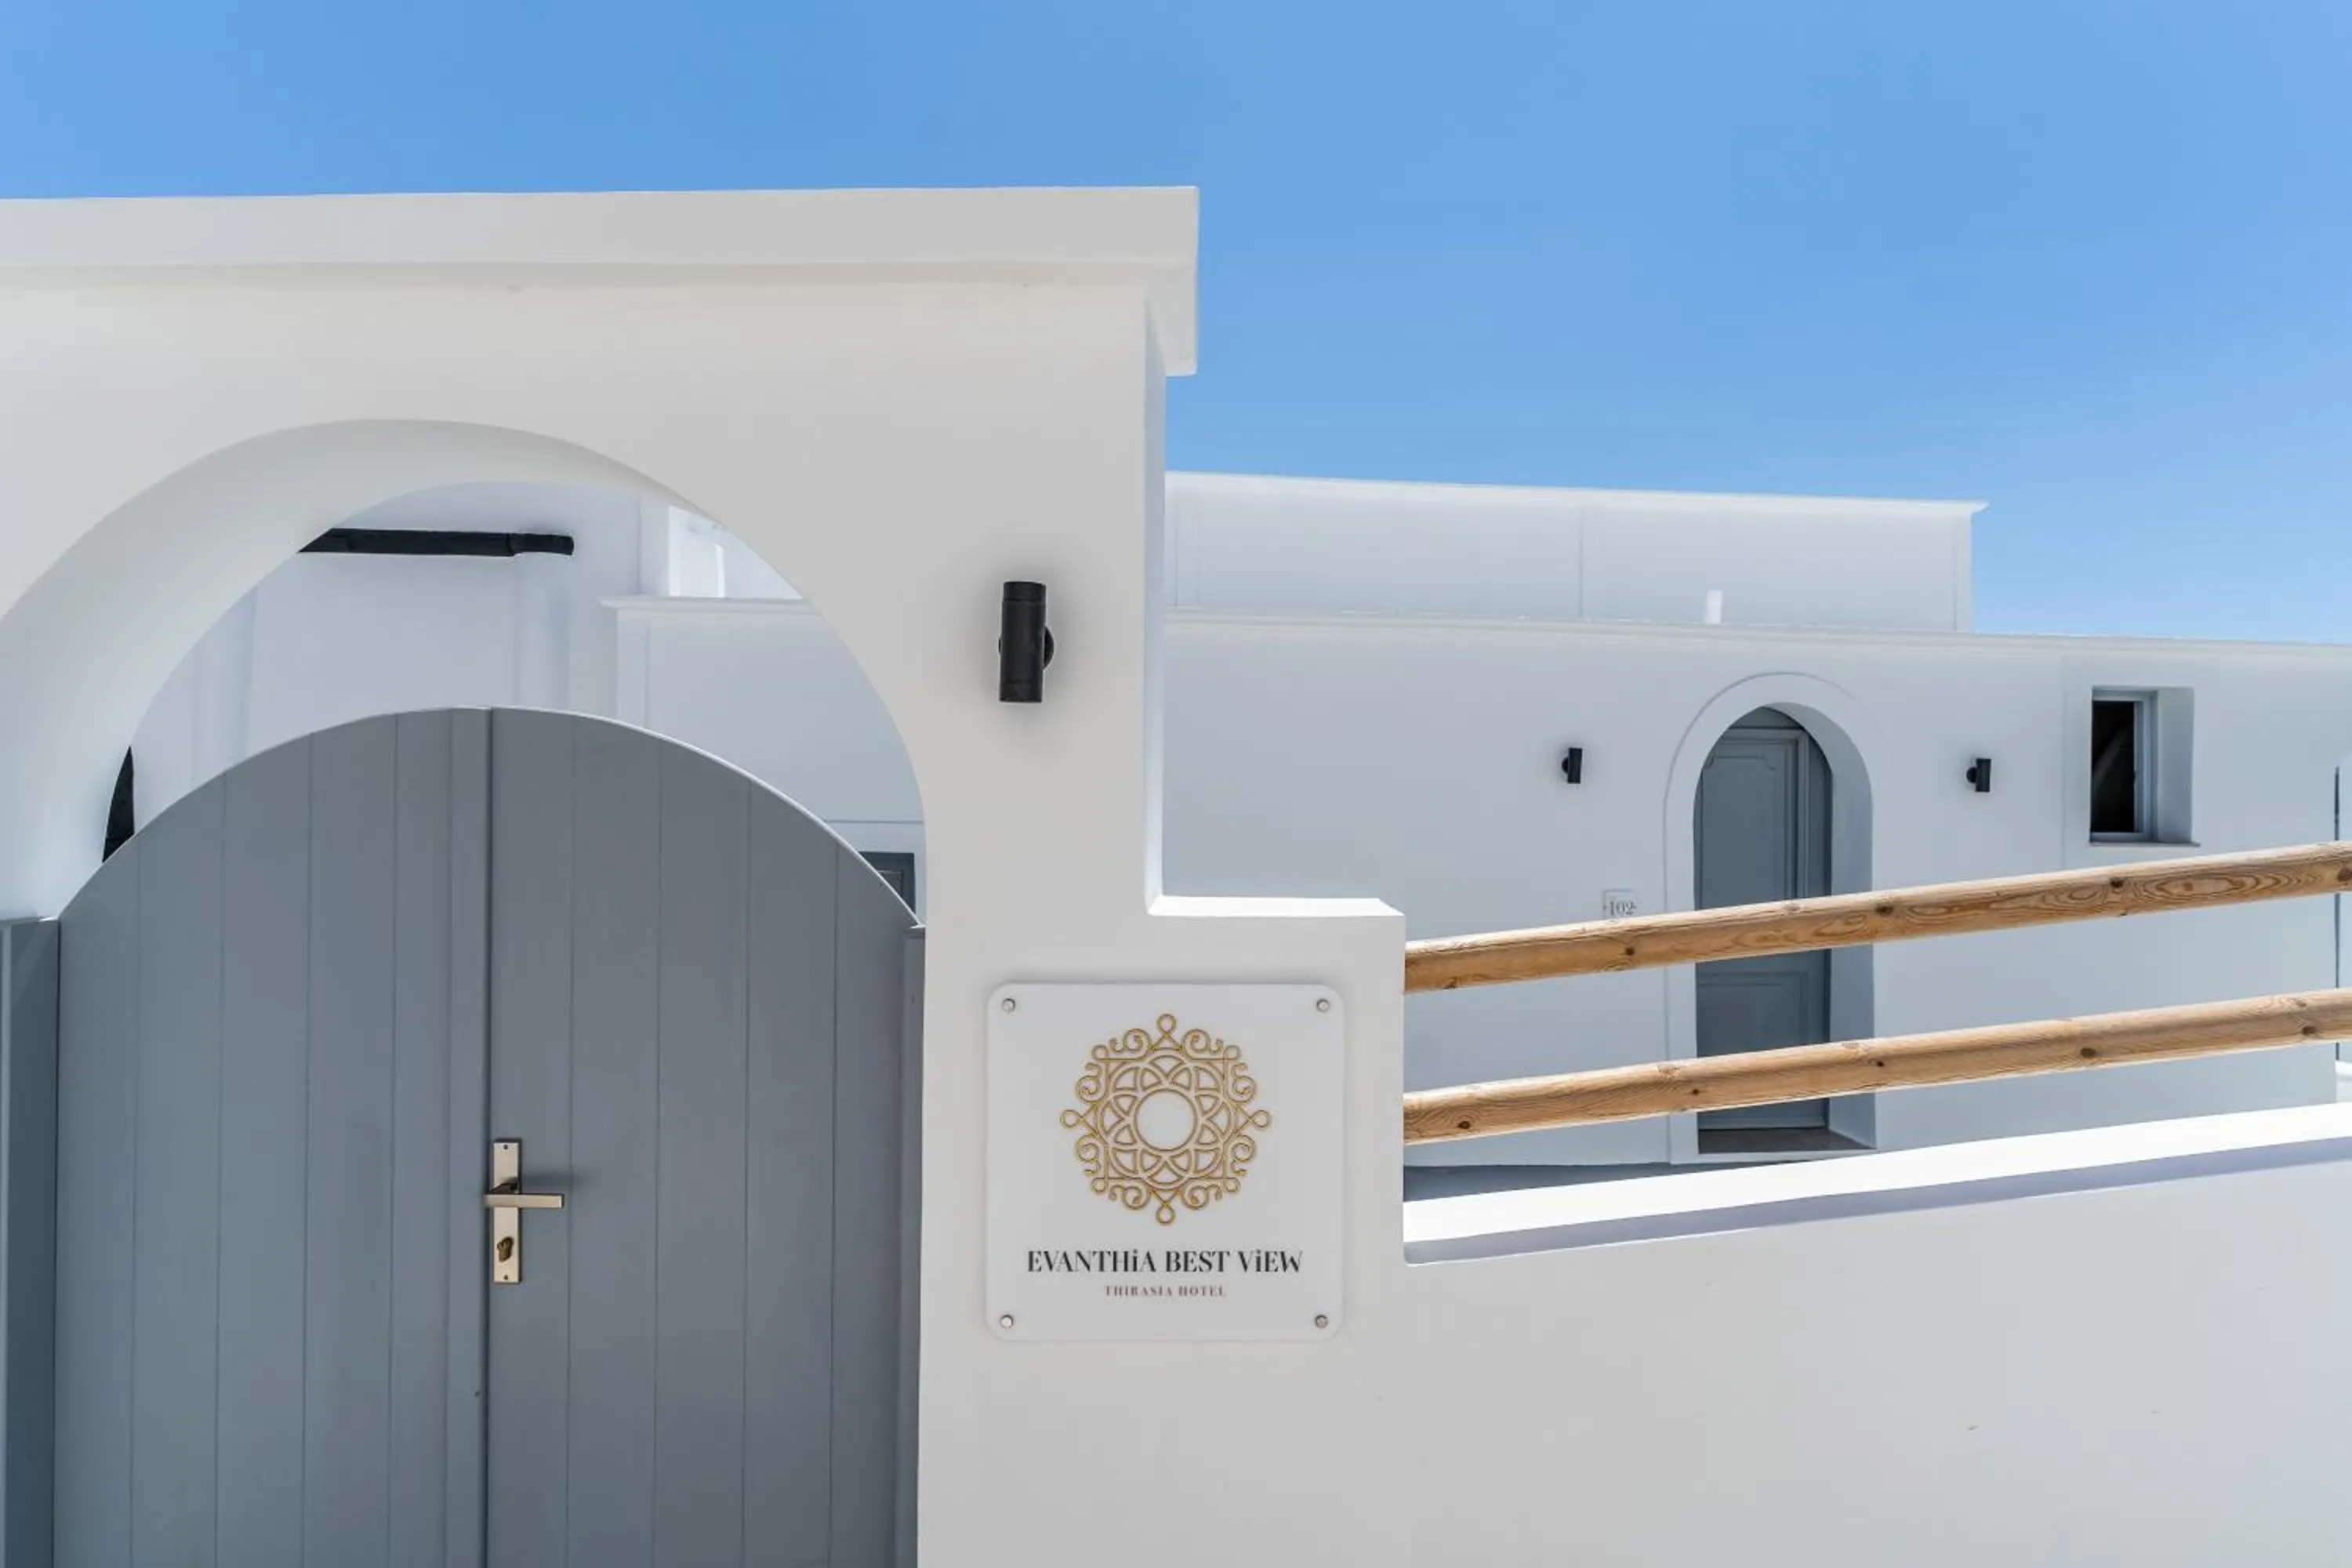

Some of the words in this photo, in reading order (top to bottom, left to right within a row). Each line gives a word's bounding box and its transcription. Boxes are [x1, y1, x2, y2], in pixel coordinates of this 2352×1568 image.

[1165, 1250, 1230, 1272] BEST
[1105, 1285, 1173, 1297] THIRASIA
[1178, 1285, 1226, 1297] HOTEL
